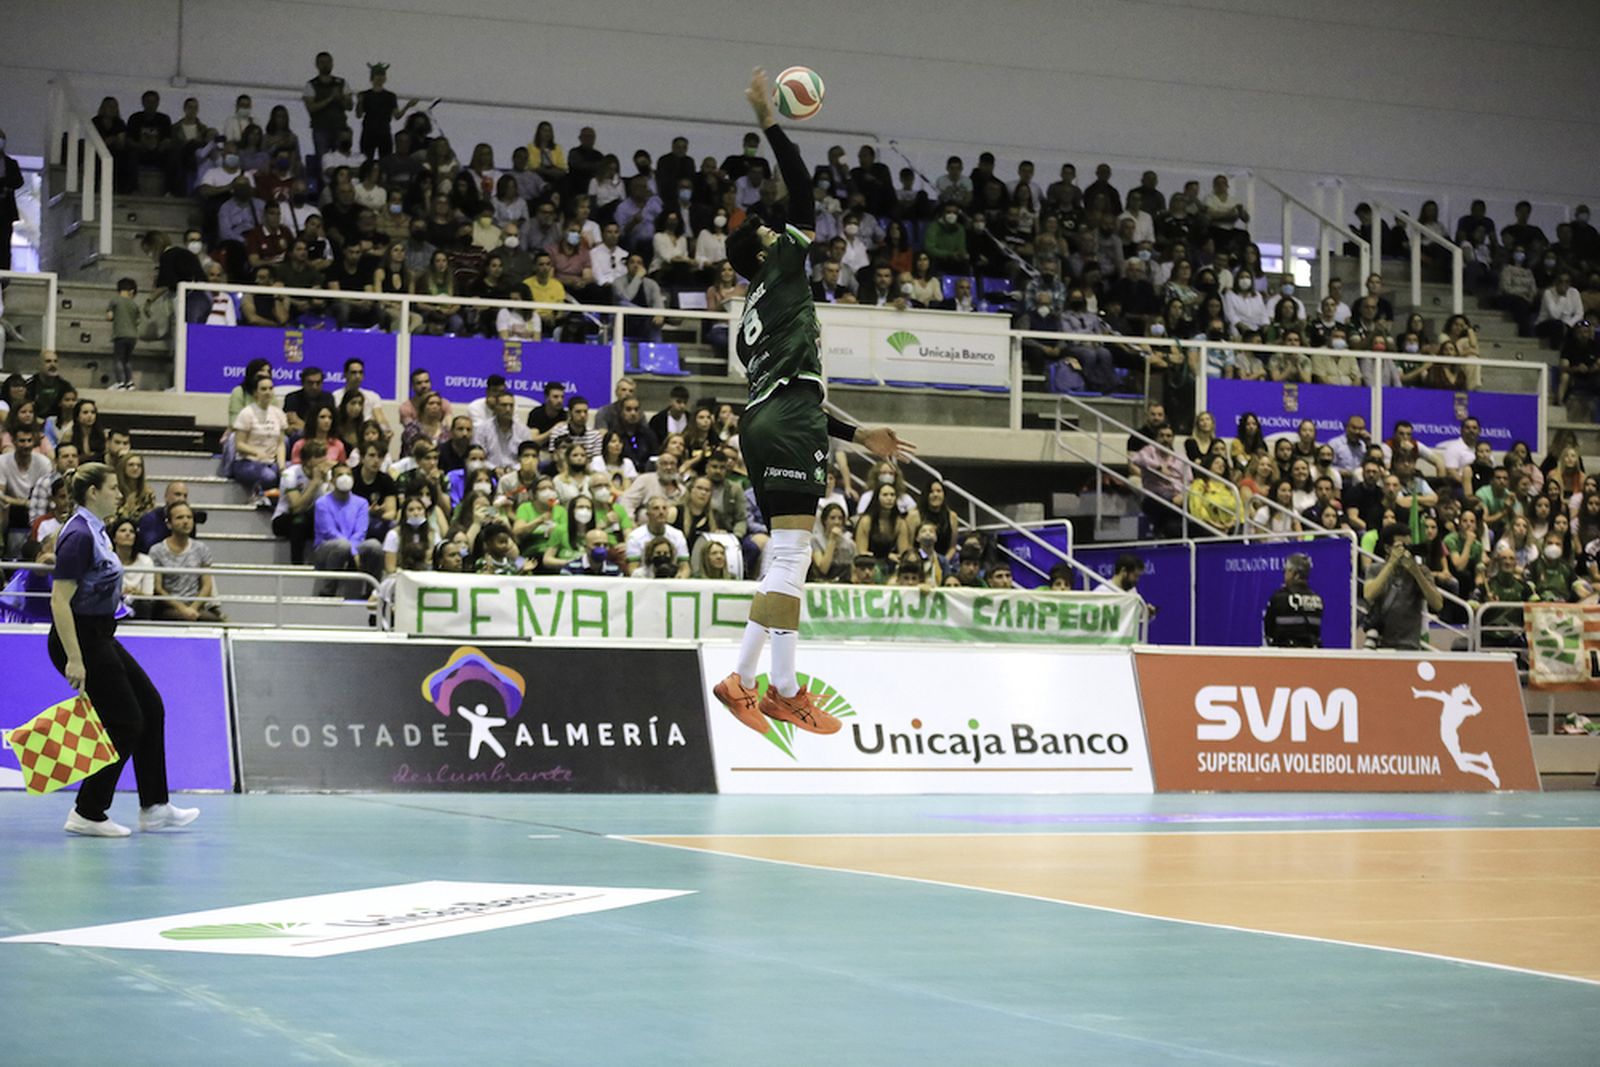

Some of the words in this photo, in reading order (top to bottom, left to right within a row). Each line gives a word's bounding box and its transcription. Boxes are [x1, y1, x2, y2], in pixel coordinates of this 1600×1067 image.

[919, 347, 961, 361] Unicaja
[962, 349, 996, 361] Banco
[514, 379, 529, 391] DE
[972, 596, 1121, 632] CAMPEON
[1195, 685, 1359, 743] SVM
[514, 716, 687, 747] ALMERÍA
[852, 718, 1006, 764] Unicaja
[1011, 723, 1129, 755] Banco
[391, 762, 575, 783] deslumbrante
[1197, 752, 1281, 774] SUPERLIGA
[1285, 753, 1355, 775] VOLEIBOL
[1357, 755, 1441, 776] MASCULINA
